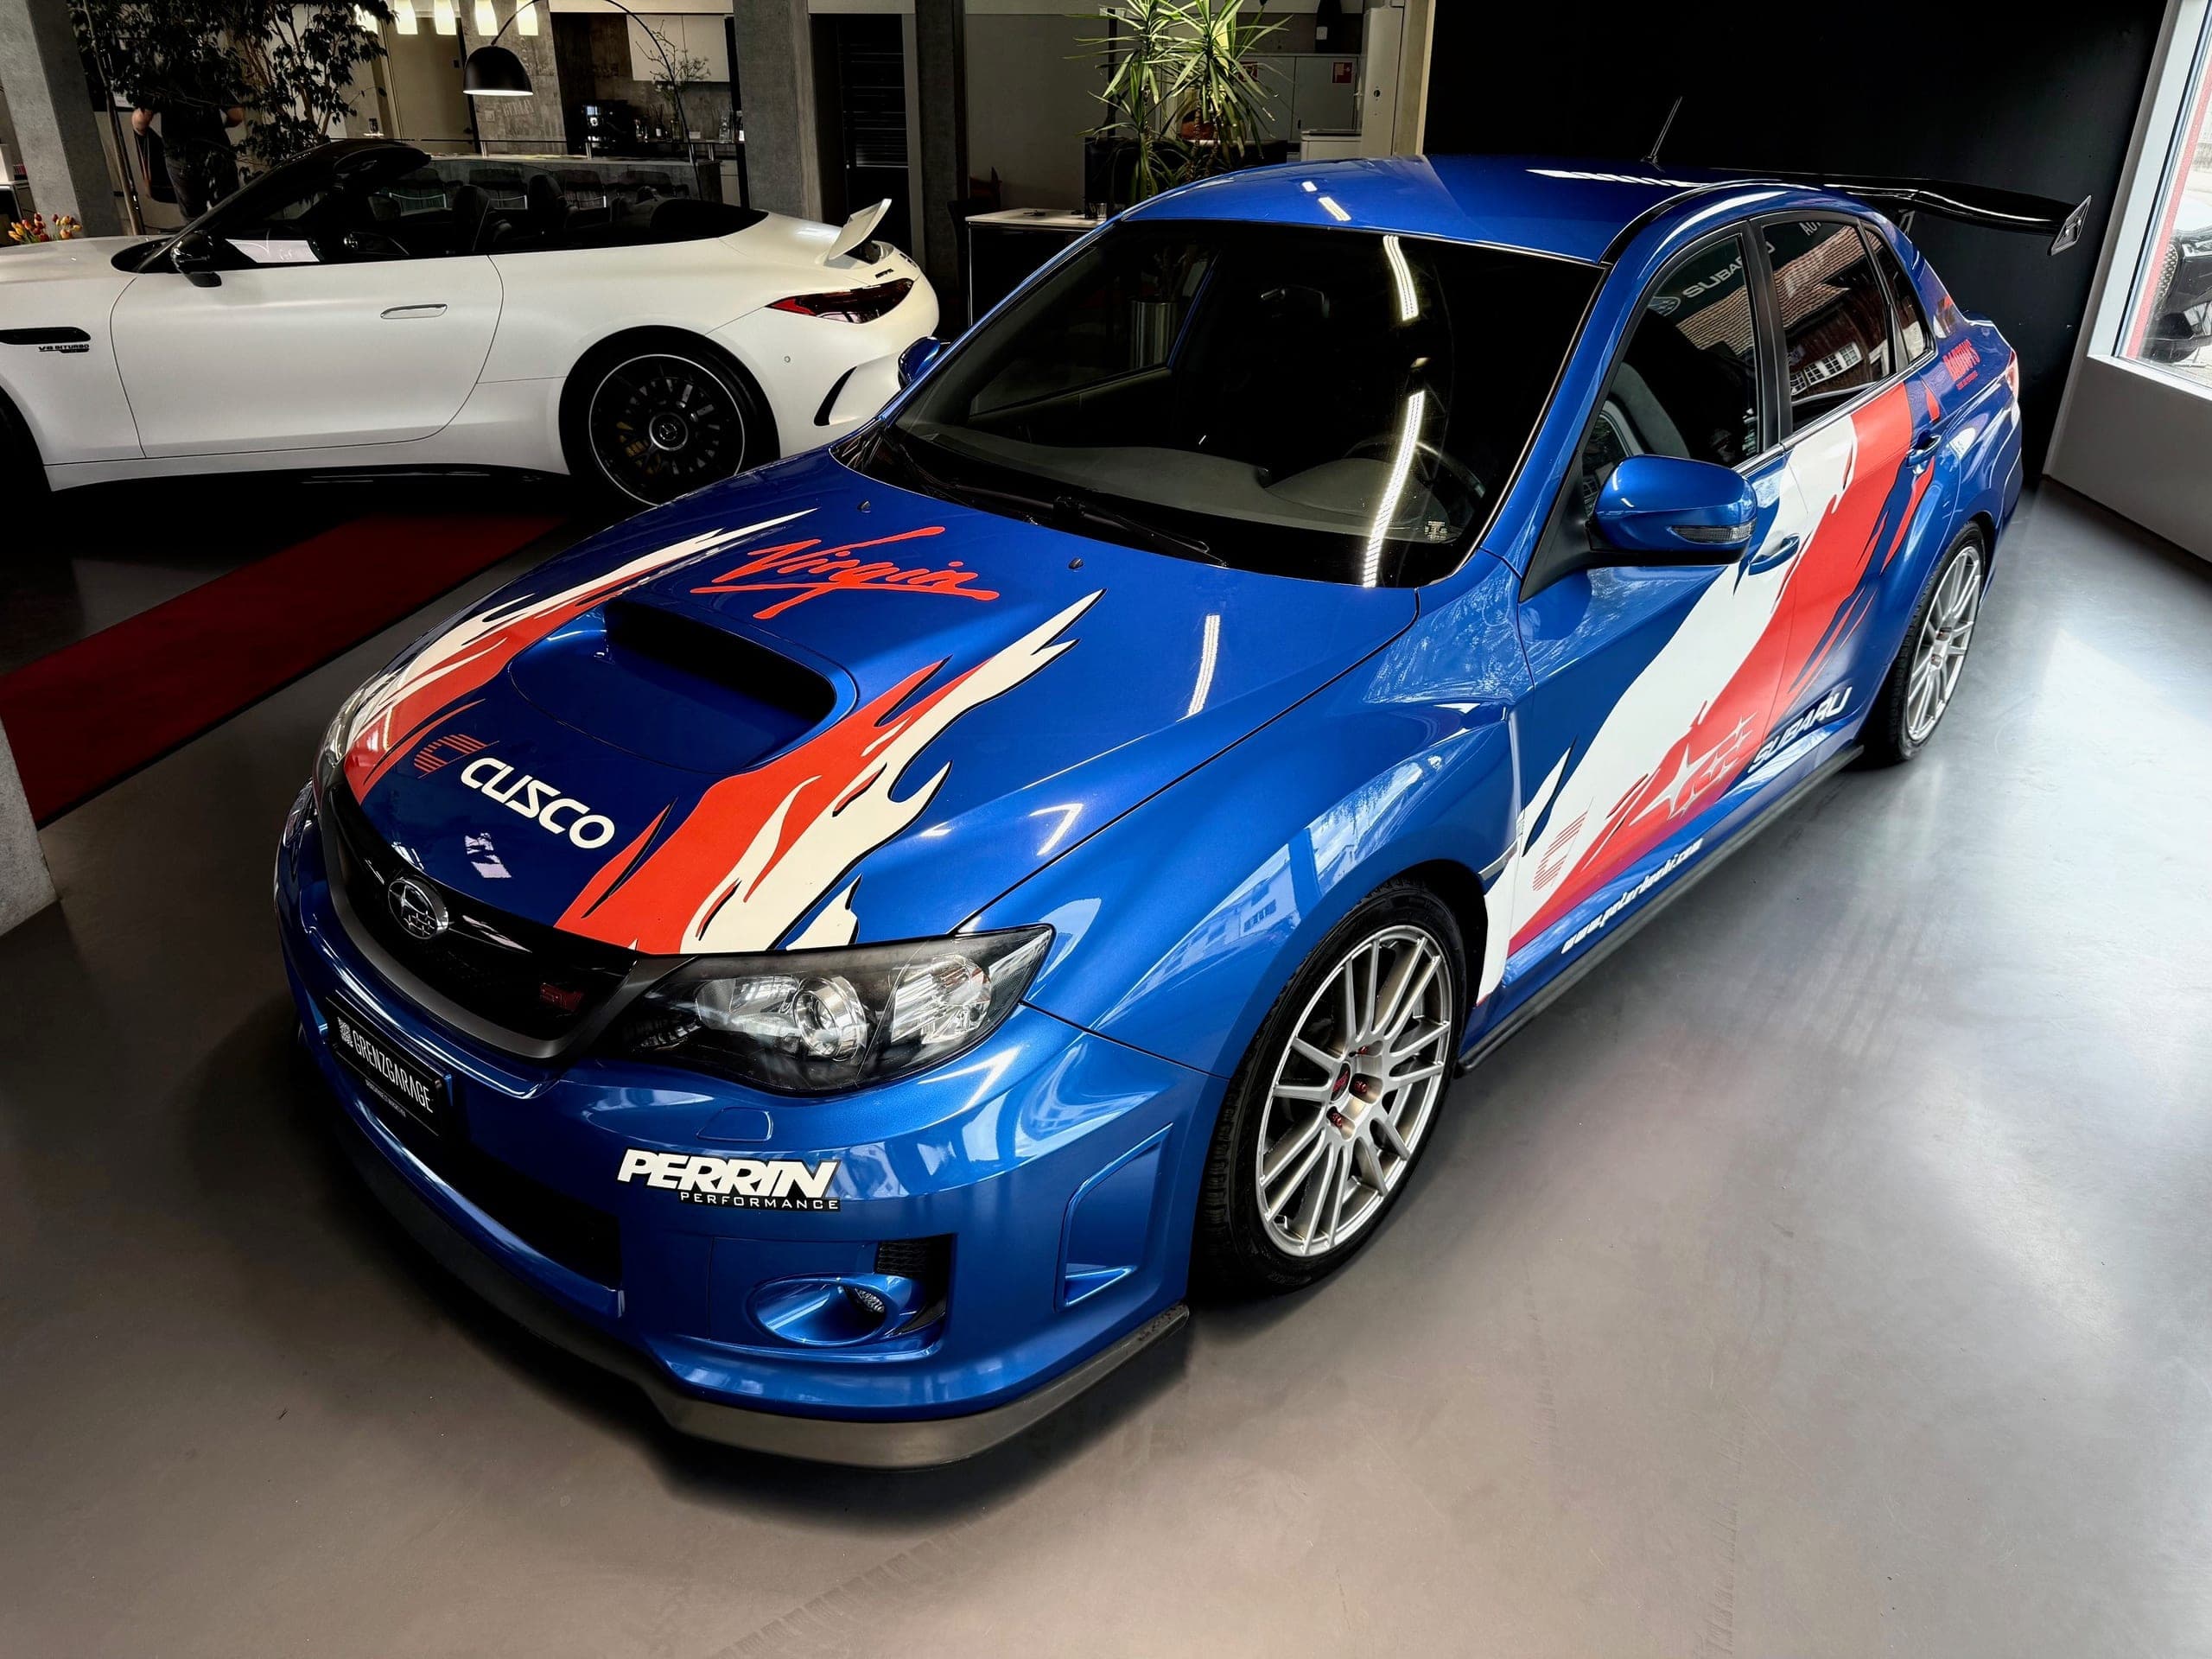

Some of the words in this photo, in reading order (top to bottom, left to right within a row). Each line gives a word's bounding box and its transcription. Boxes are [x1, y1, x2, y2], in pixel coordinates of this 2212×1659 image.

[690, 526, 1000, 619] Virgin
[1747, 686, 1853, 773] SUBARU
[461, 758, 615, 849] CUSCO
[353, 1030, 433, 1113] GRENZGARAGE
[617, 1148, 838, 1198] PERRIN
[680, 1192, 838, 1210] PERFORMANCE
